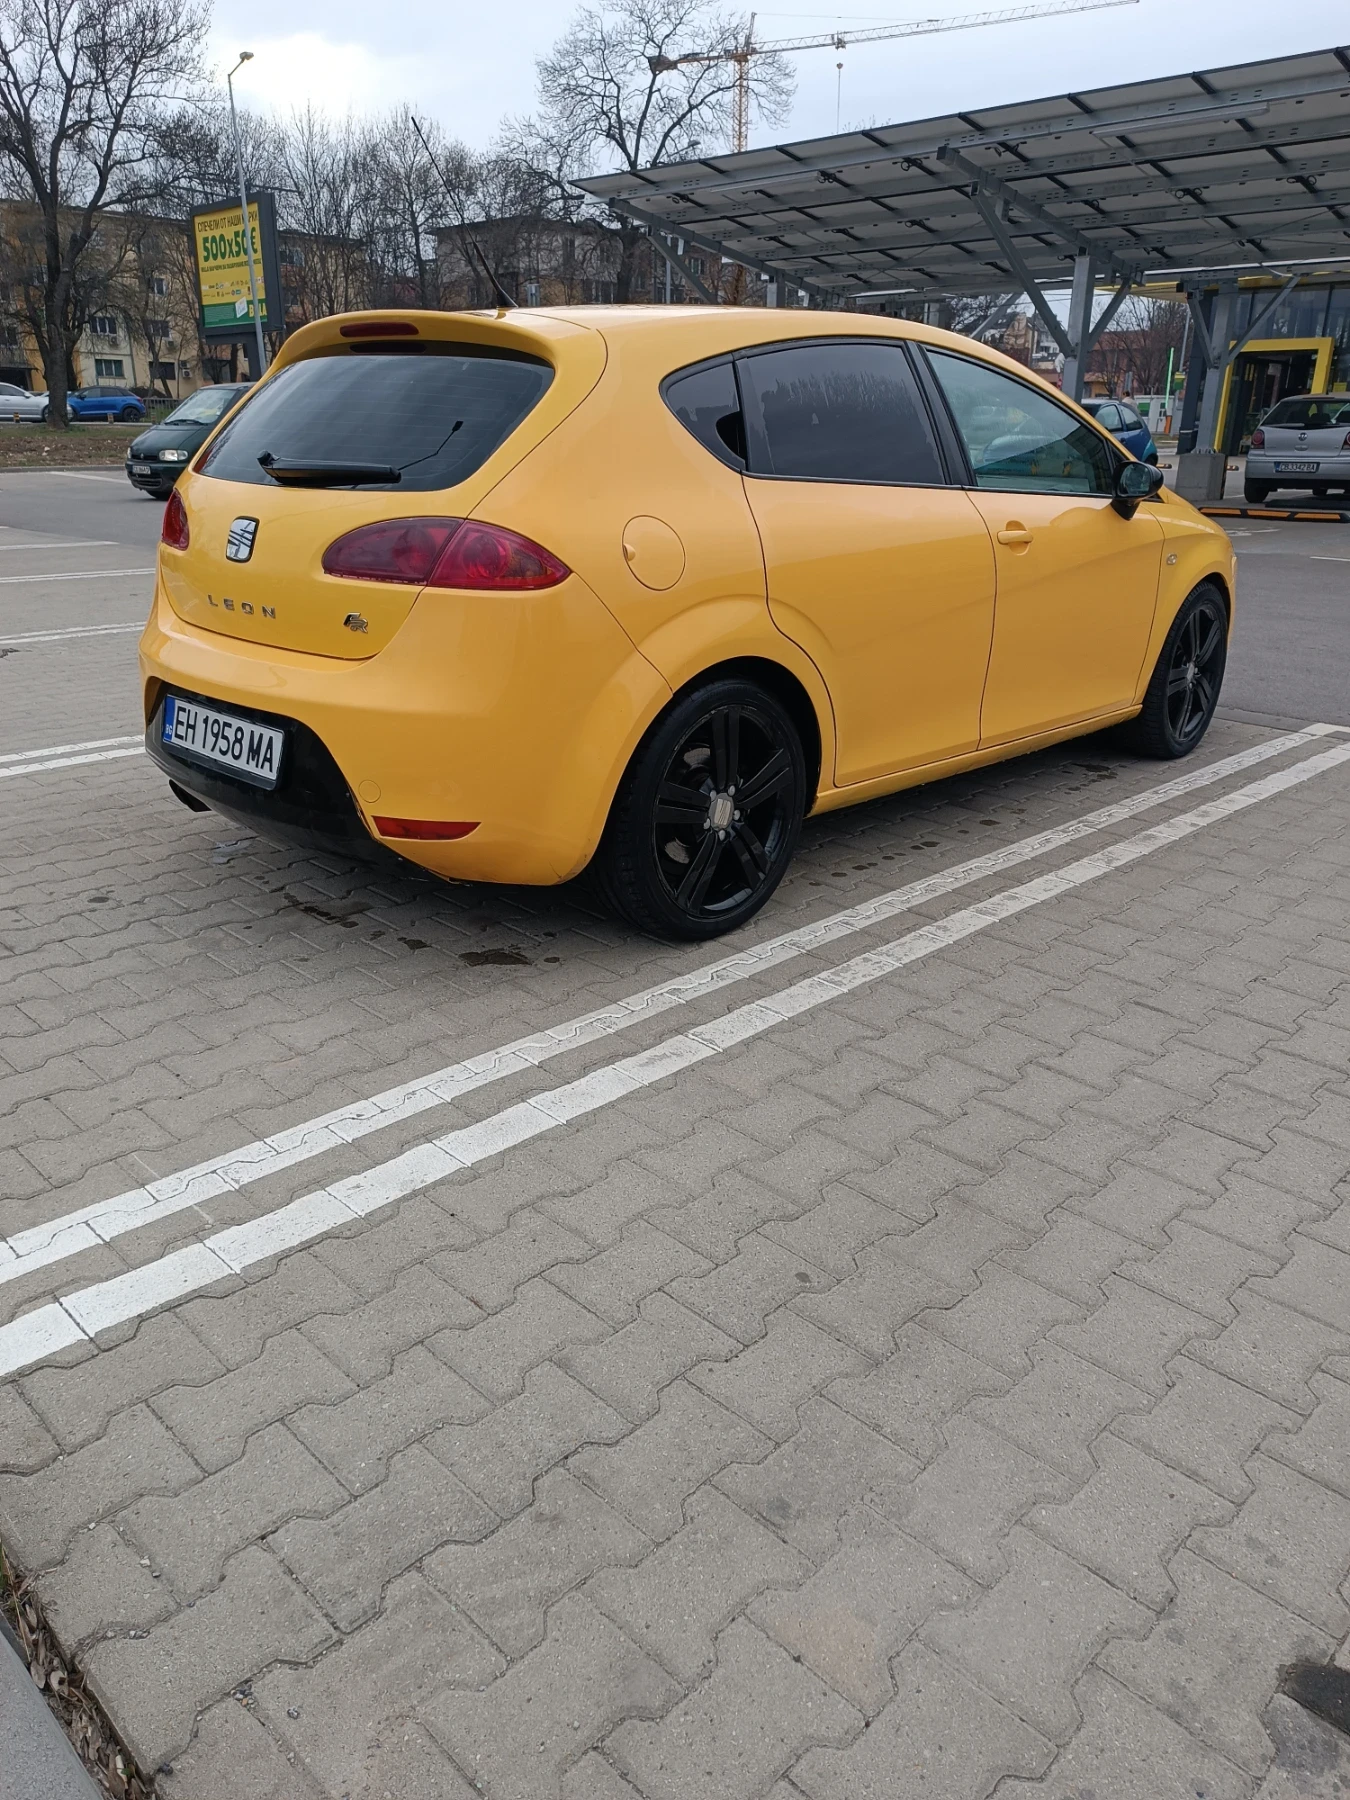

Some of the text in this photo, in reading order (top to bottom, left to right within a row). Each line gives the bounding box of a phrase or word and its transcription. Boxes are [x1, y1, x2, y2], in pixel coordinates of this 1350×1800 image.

[219, 217, 226, 229] ОТ
[207, 594, 276, 619] LEON
[165, 724, 173, 735] BG
[174, 706, 273, 773] EH 1958 MA
